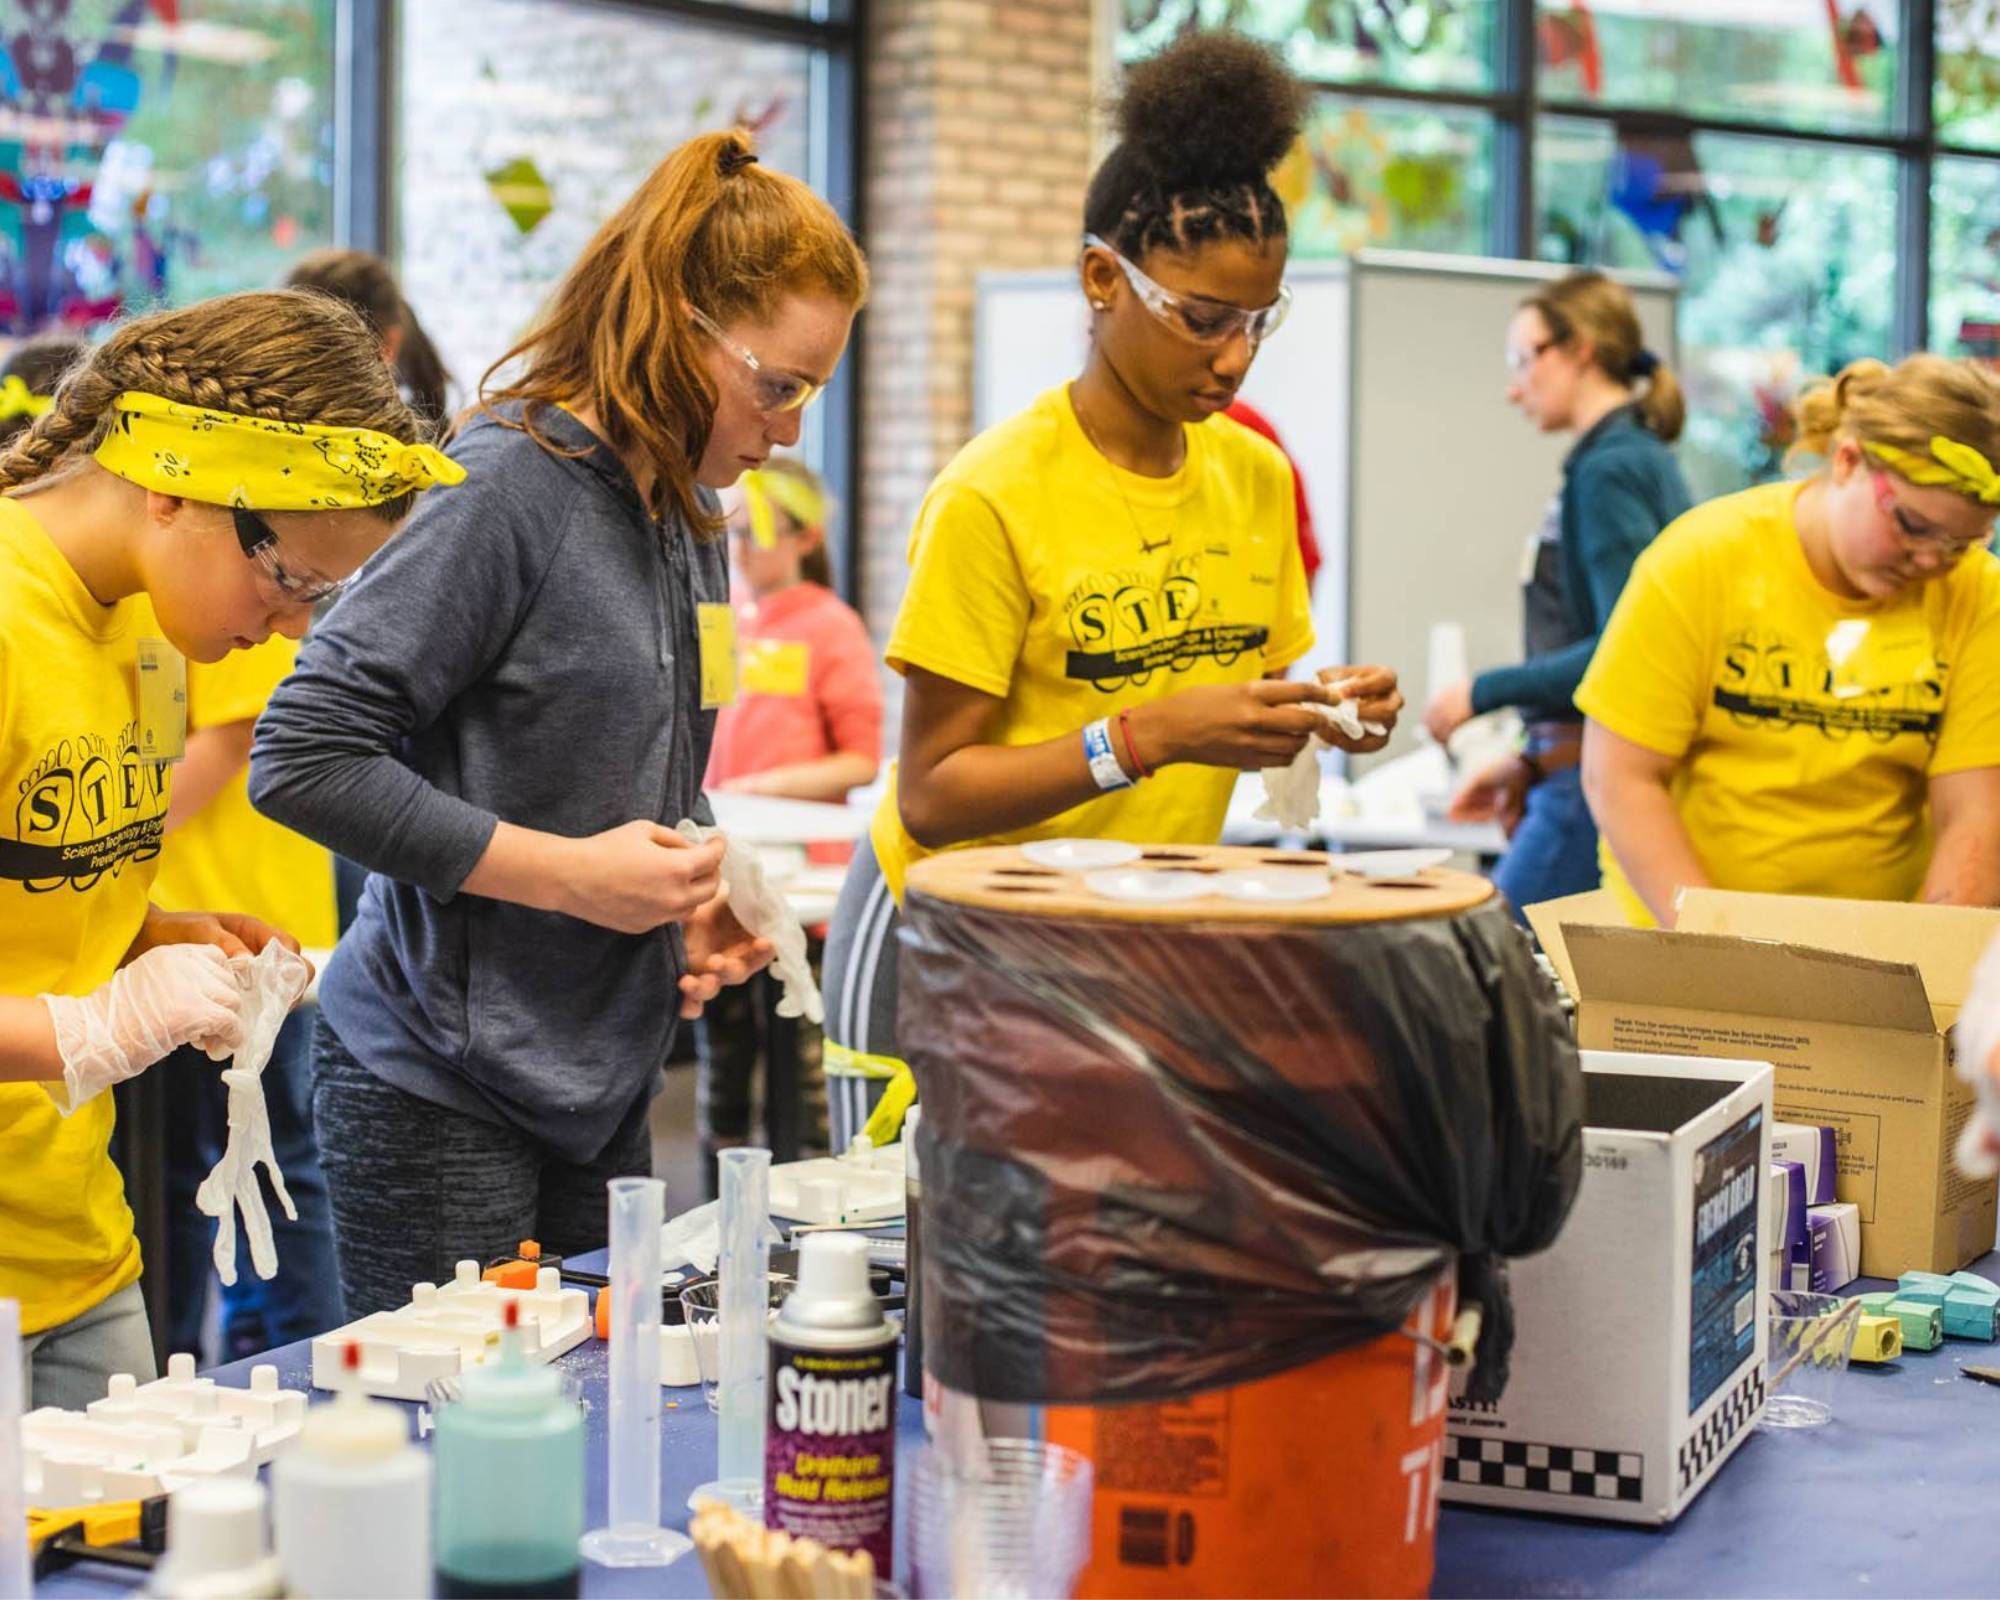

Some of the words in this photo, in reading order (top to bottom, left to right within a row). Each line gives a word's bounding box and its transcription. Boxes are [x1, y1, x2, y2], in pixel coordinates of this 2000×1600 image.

[61, 840, 104, 861] Science
[775, 1365, 893, 1437] Stoner
[1447, 1395, 1499, 1414] ASTY!
